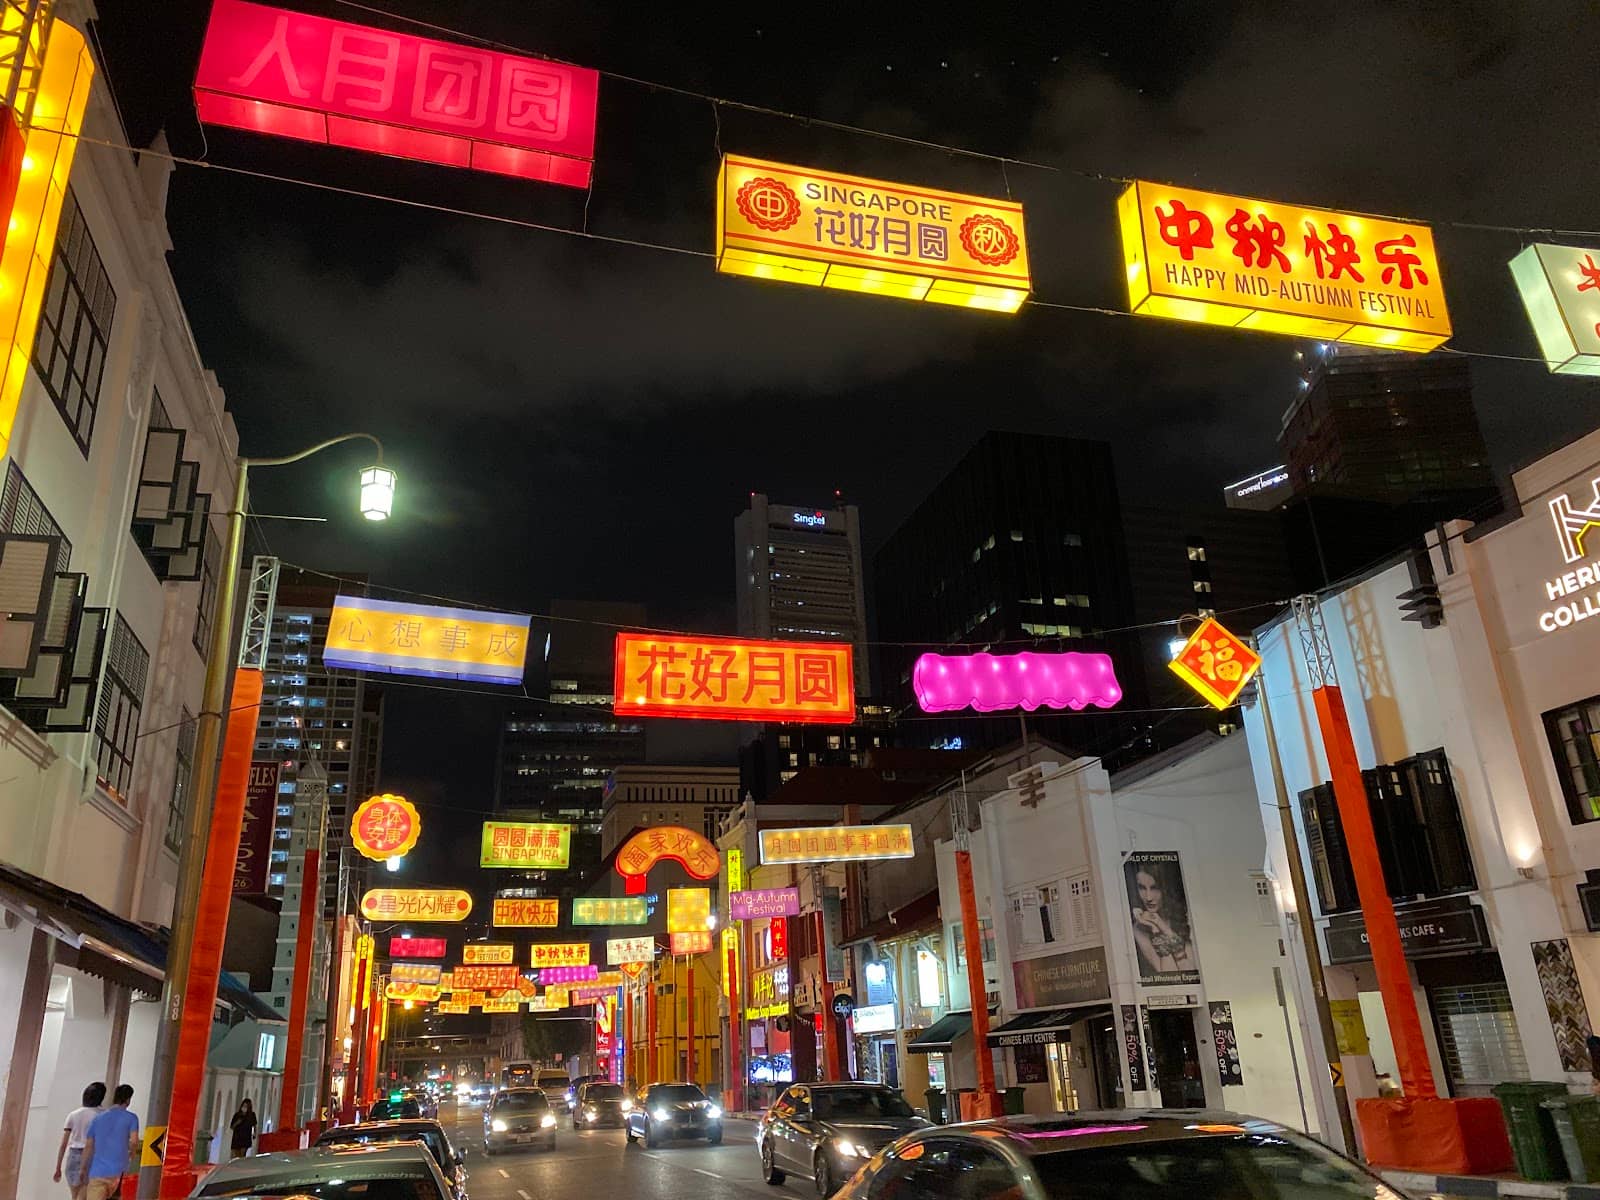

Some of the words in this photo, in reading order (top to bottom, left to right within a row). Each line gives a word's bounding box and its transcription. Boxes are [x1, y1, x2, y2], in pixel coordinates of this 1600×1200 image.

[228, 15, 572, 142] 人月团圆
[805, 182, 953, 223] SINGAPORE
[814, 206, 948, 262] 花好月圆
[1154, 199, 1429, 290] 中秋快乐
[1164, 263, 1226, 291] HAPPY
[1234, 272, 1353, 309] MID-AUTUMN
[1358, 290, 1435, 320] FESTIVAL
[793, 513, 826, 526] Singtel
[1545, 560, 1600, 601] HERI
[339, 616, 521, 659] 心想事成
[1198, 638, 1243, 682] 福
[637, 644, 839, 706] 花好月圆
[378, 895, 457, 914] 星光闪耀
[733, 891, 797, 905] Mid-Autumn
[747, 902, 787, 916] Festival
[496, 901, 557, 924] 中秋快乐
[1412, 924, 1436, 936] CAFE
[998, 1034, 1022, 1046] CHINESE
[1022, 1033, 1033, 1044] ART
[1033, 1031, 1057, 1044] CENTRE
[1126, 1035, 1138, 1063] 50%
[1215, 1029, 1227, 1057] 50%
[1130, 1066, 1139, 1084] OFF
[1219, 1058, 1228, 1076] OFF
